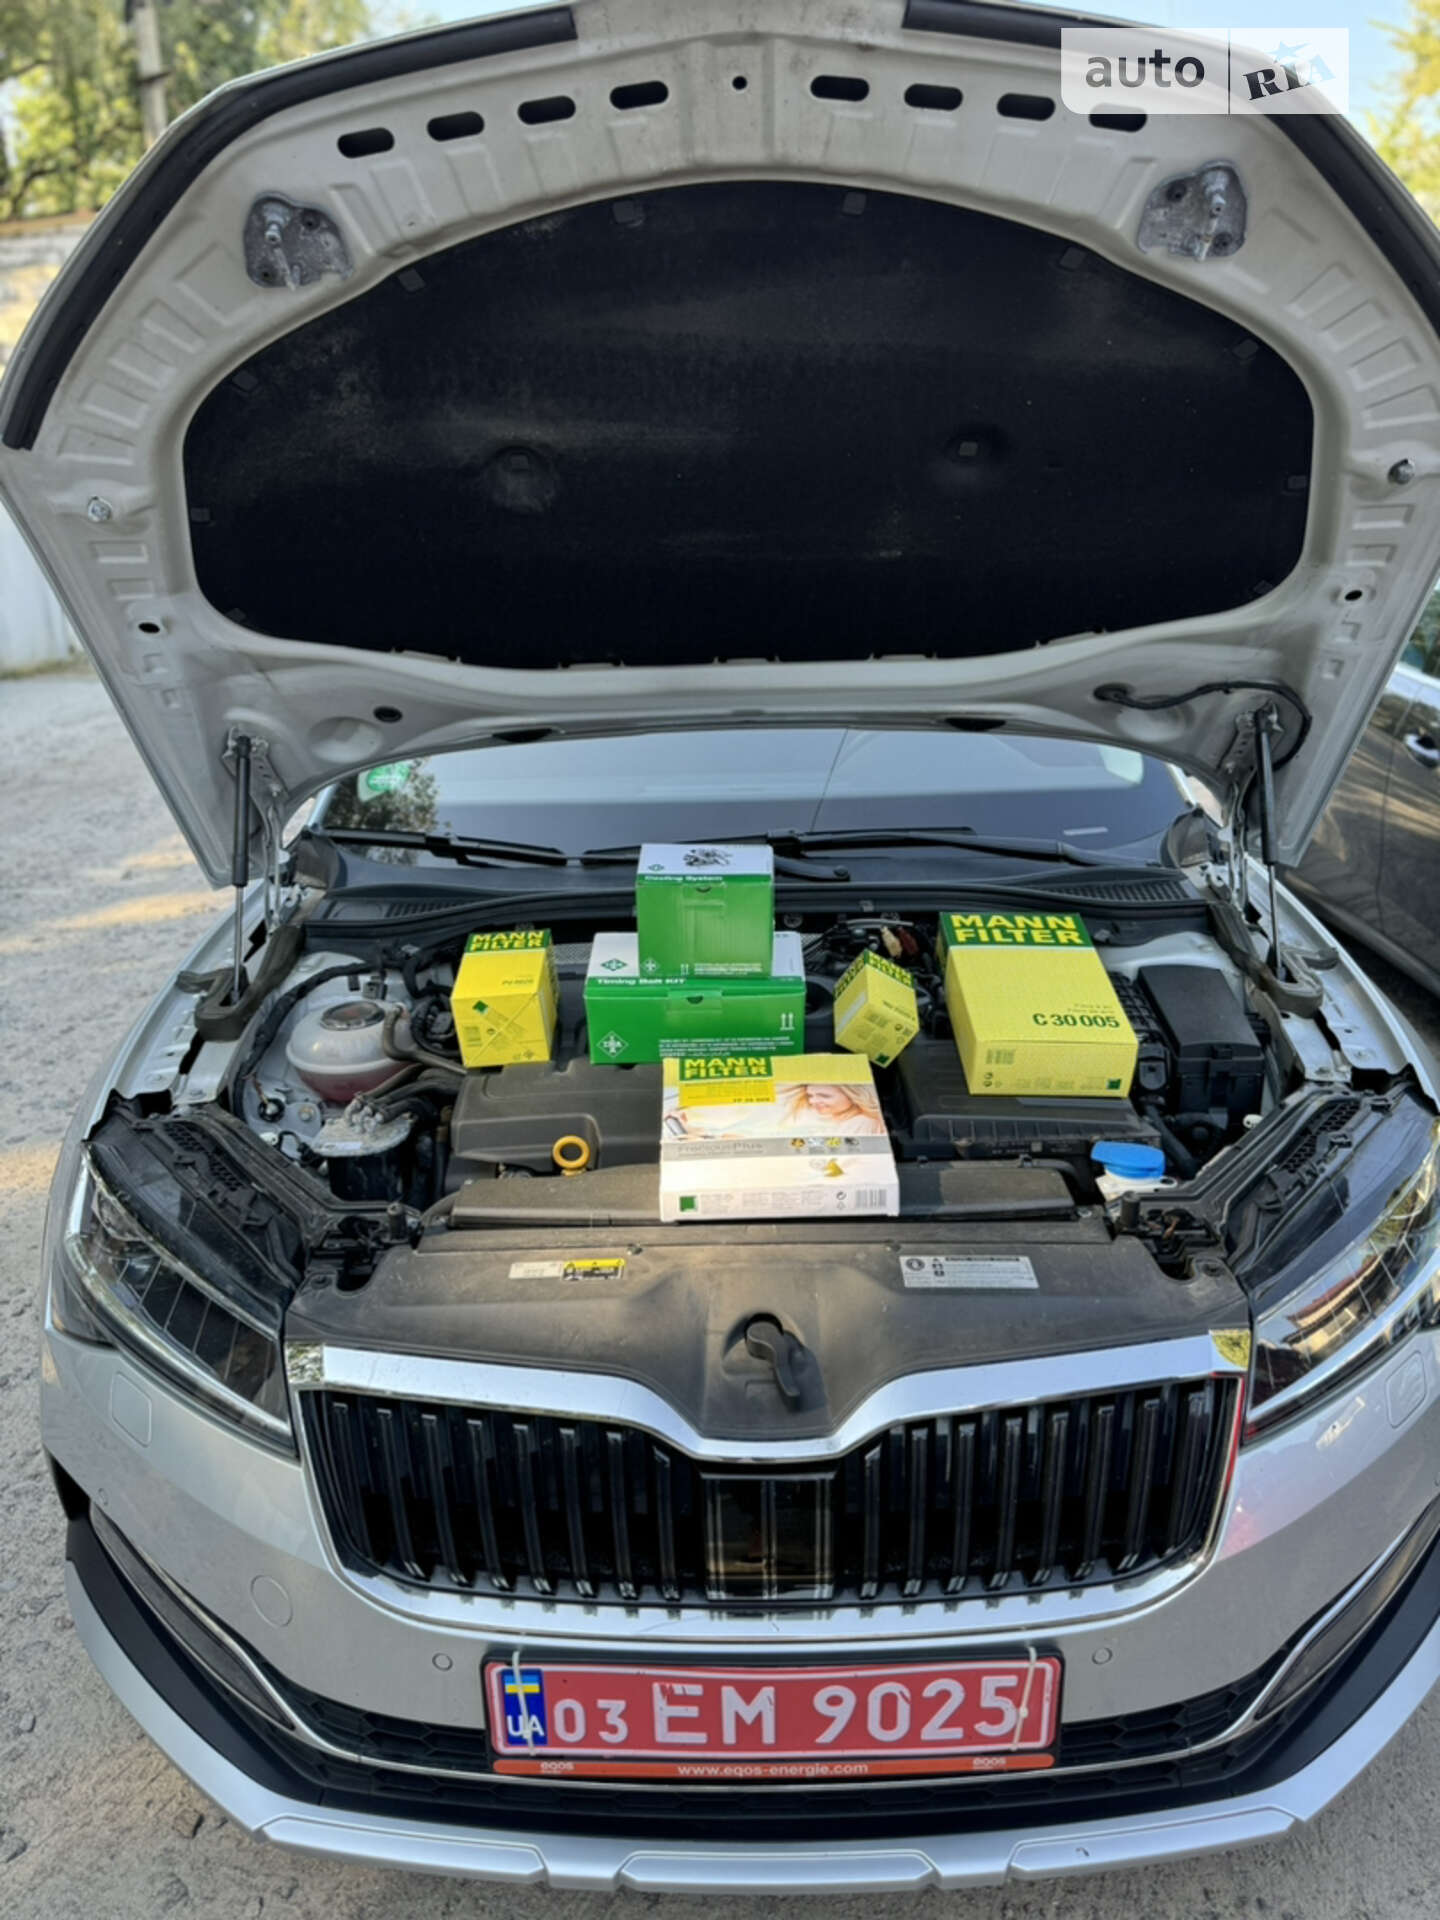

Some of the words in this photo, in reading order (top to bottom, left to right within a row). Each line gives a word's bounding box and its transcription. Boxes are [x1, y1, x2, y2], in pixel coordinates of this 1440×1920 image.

[950, 914, 1077, 929] MANN
[472, 931, 544, 942] MANN
[955, 928, 1083, 944] FILTER
[470, 938, 543, 951] FILTER
[1033, 1013, 1048, 1026] C
[1051, 1014, 1077, 1027] 30
[1080, 1014, 1120, 1028] 005
[684, 1057, 766, 1068] MANN
[685, 1065, 768, 1079] FILTER
[507, 1714, 545, 1736] UA
[553, 1698, 628, 1743] 03
[653, 1681, 775, 1745] EM
[814, 1675, 1019, 1746] 9025
[677, 1762, 869, 1777] www.eqos-energie.com
